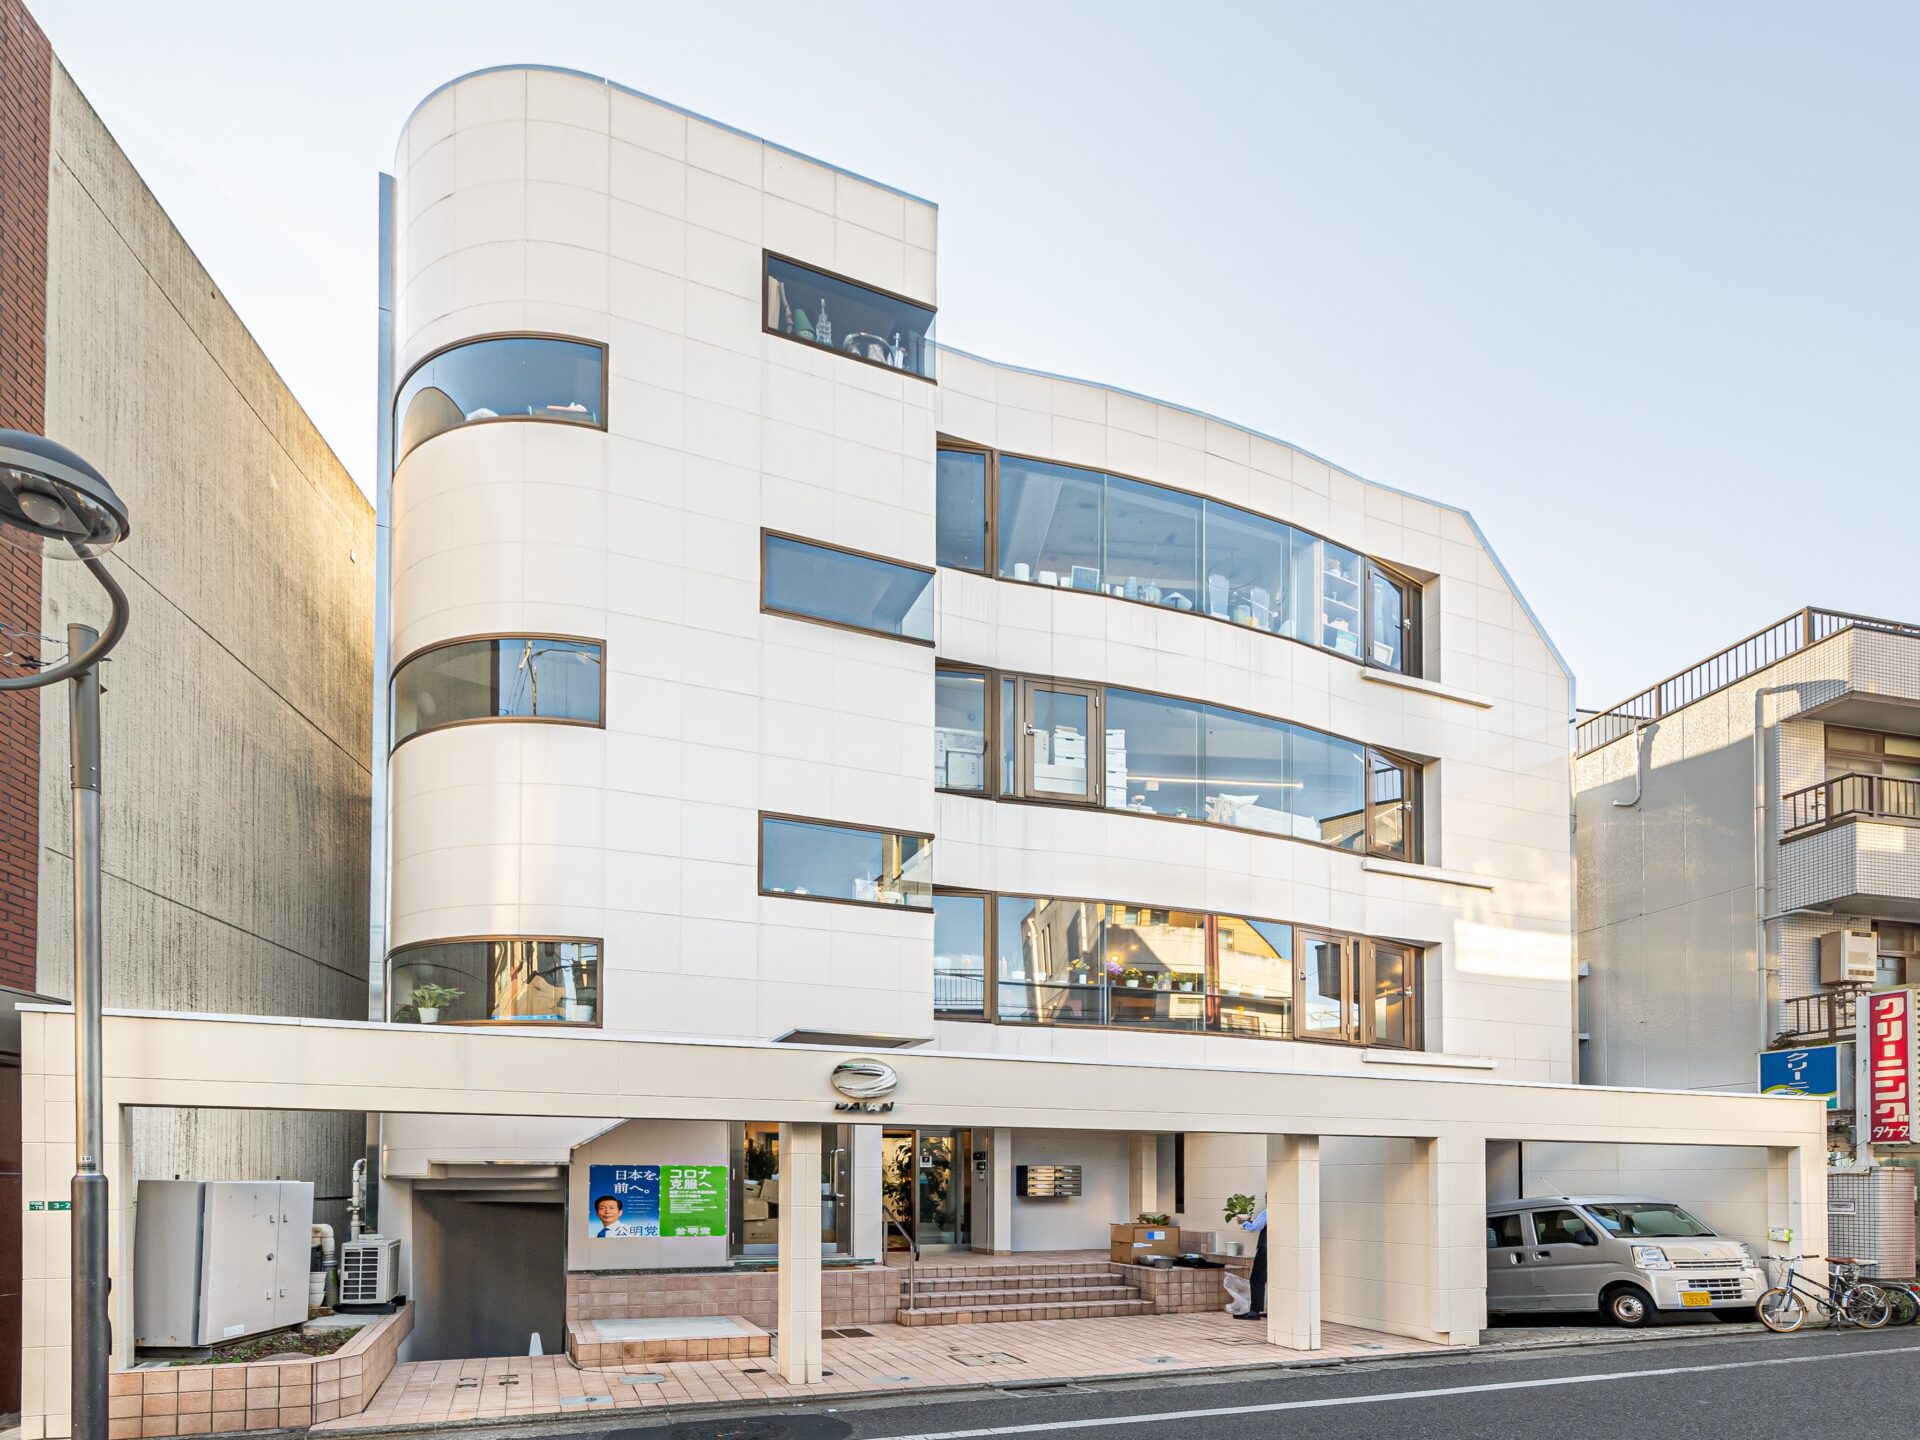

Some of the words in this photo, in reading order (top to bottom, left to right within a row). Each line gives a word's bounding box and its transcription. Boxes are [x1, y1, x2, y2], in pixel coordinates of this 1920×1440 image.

[1875, 997, 1909, 1123] クリーニング
[615, 1170, 659, 1181] 日本を、
[670, 1169, 712, 1179] コロナ
[614, 1183, 650, 1194] 前へ。
[669, 1179, 712, 1190] 克服へ
[615, 1226, 658, 1236] 公明党
